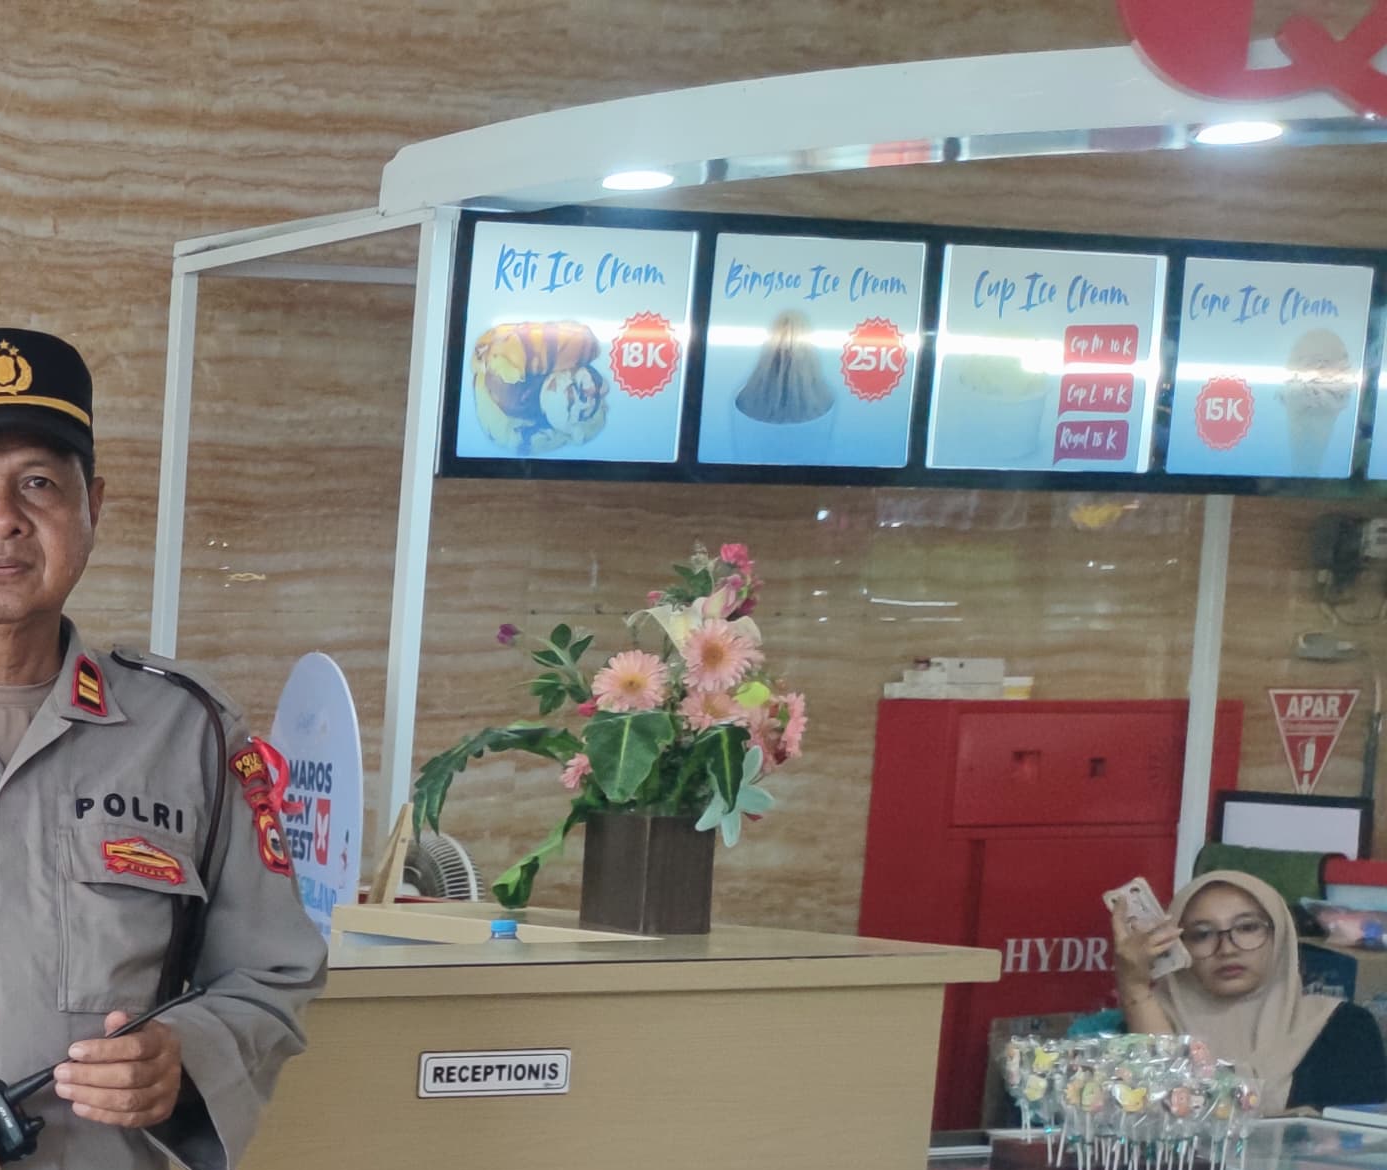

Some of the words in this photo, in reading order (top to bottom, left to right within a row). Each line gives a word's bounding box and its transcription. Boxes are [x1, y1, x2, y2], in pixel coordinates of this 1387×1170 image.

[494, 243, 540, 292] Roti
[540, 250, 585, 293] Ice
[595, 252, 665, 294] Cream
[725, 257, 802, 299] Bingsoo
[803, 264, 840, 301] Ice
[849, 266, 907, 303] Cream
[973, 270, 1016, 319] Cup
[1018, 272, 1057, 312] Ice
[1066, 274, 1130, 314] Cream
[1189, 282, 1230, 321] Cone
[1232, 284, 1270, 325] Ice
[1279, 287, 1339, 326] Cream
[1287, 695, 1340, 717] APAR
[289, 759, 333, 794] MAROS
[75, 793, 184, 834] POLRI
[1003, 938, 1115, 973] HYDR
[432, 1063, 559, 1083] RECEPTIONIS
